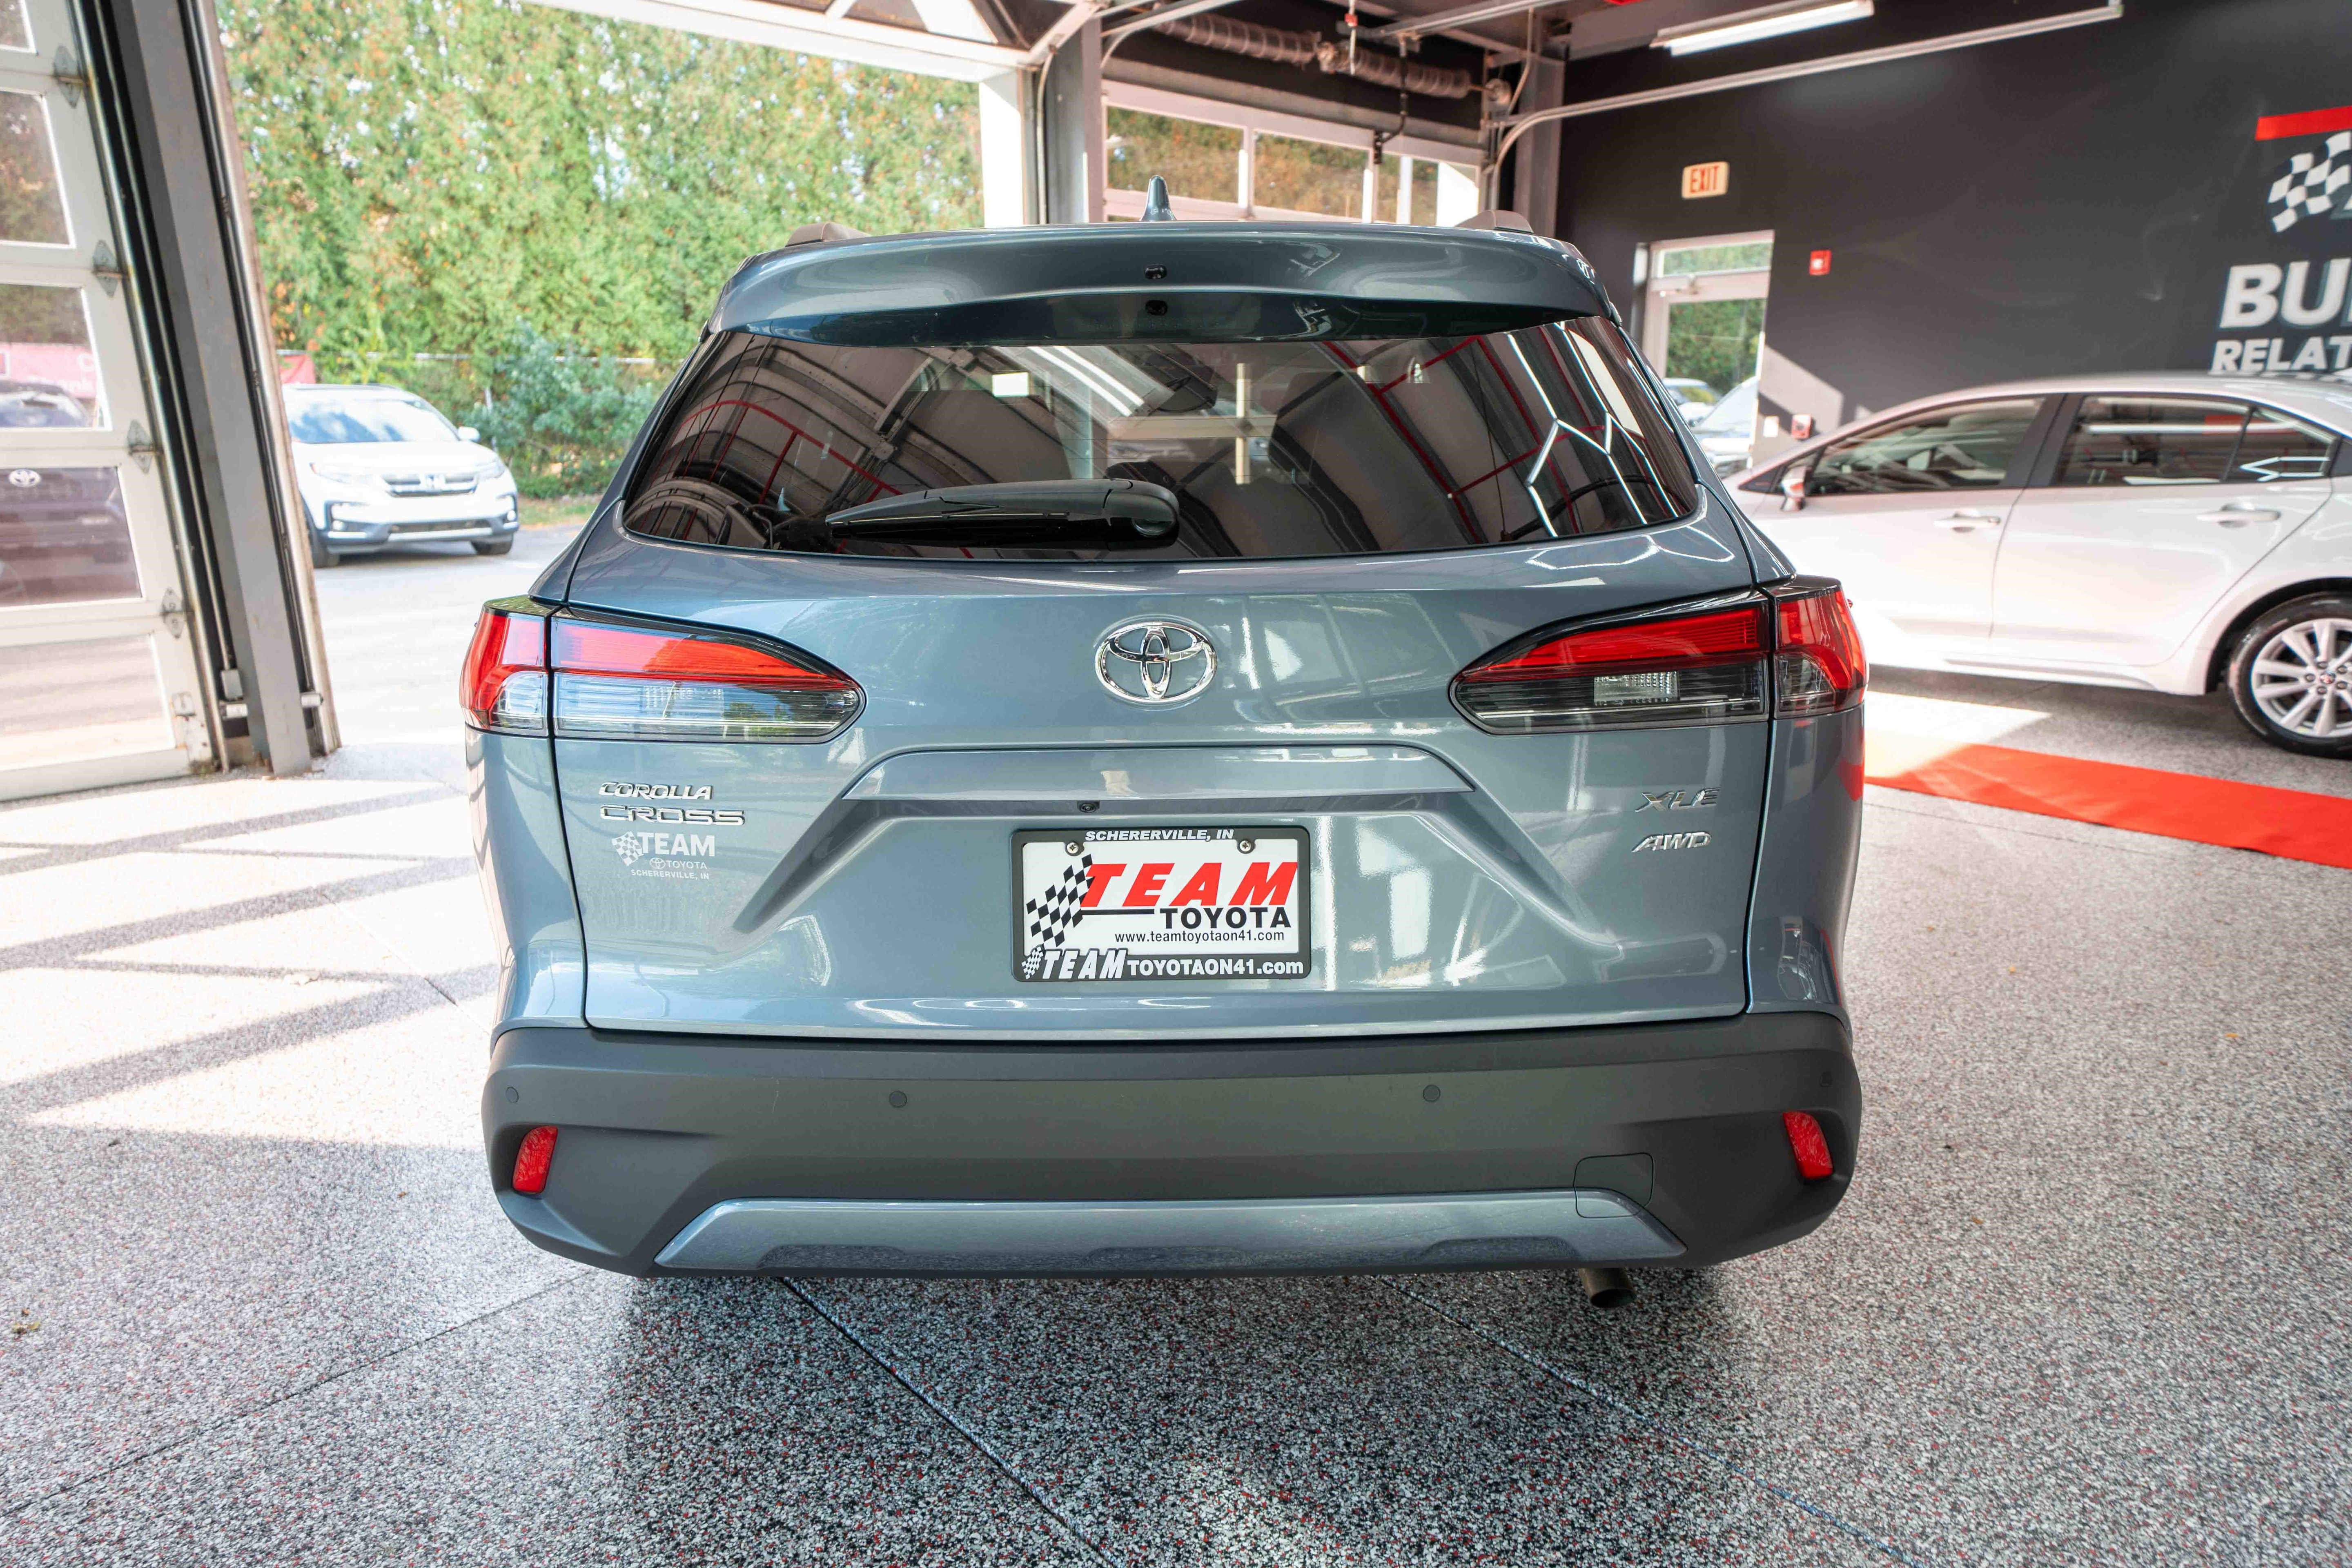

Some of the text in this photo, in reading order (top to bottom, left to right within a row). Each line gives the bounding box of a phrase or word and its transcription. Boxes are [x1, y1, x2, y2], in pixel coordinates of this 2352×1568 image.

[1690, 166, 1719, 193] EXIT
[2219, 258, 2352, 328] BU
[599, 781, 713, 800] COROLLA
[1635, 787, 1720, 812] XLE
[600, 804, 745, 826] CROSS
[637, 832, 715, 857] TEAM
[1085, 829, 1234, 842] SCHERERVILLE, IN
[1631, 831, 1711, 853] AWD
[630, 869, 698, 880] SCHERERVILLE,
[666, 860, 707, 869] TOYOTA
[1080, 862, 1297, 907] TEAM
[1160, 907, 1291, 929] TOYOTA
[1115, 930, 1284, 944] www.teamtoyotaon41.com
[1042, 949, 1303, 979] TEAM TOYOTAON41.com
